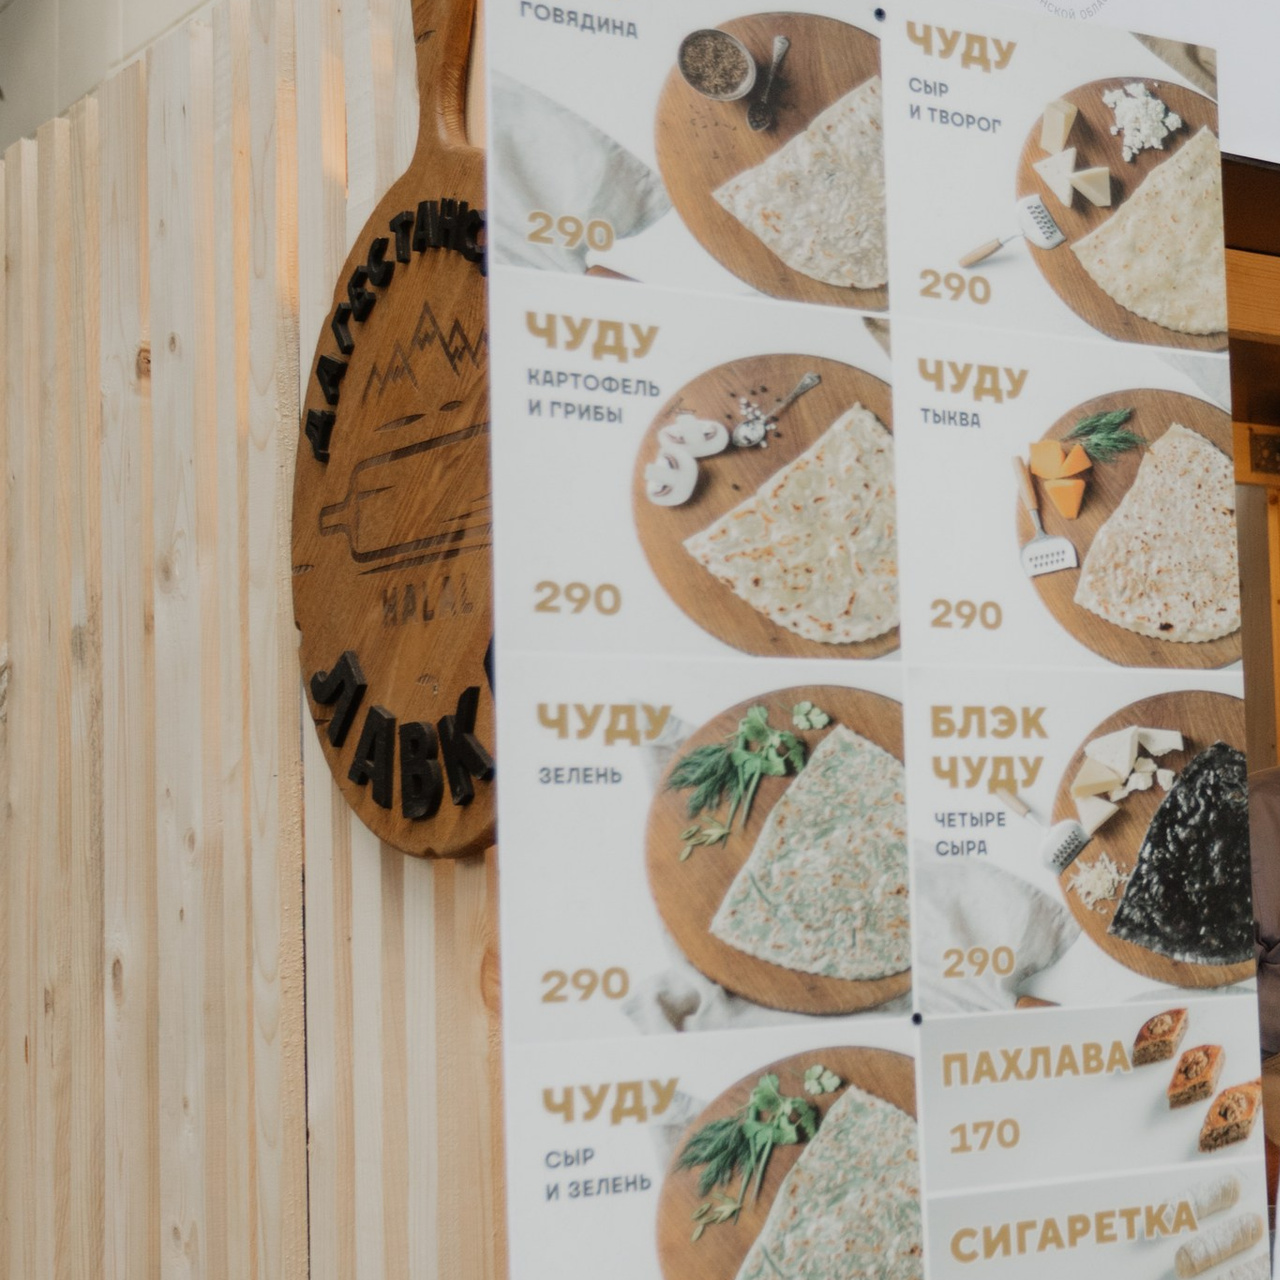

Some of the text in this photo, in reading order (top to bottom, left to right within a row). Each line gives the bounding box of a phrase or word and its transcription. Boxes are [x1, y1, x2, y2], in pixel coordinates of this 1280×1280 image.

[518, 0, 640, 40] ГОВЯДИНА
[906, 20, 1017, 72] ЧУДУ
[908, 77, 950, 98] СЫР
[909, 104, 1002, 135] И ТВОРОГ
[526, 209, 616, 253] 290
[919, 268, 992, 305] 290
[525, 310, 660, 364] ЧУДУ
[527, 367, 662, 398] КАРТОФЕЛЬ
[917, 357, 1030, 404] ЧУДУ
[527, 399, 624, 424] И ГРИБЫ
[920, 407, 982, 429] ТЫКВА
[534, 580, 623, 616] 290
[929, 598, 1003, 631] 290
[536, 702, 672, 747] ЧУДУ
[929, 705, 1049, 739] БЛЭК
[538, 766, 624, 785] ЗЕЛЕНЬ
[931, 755, 1045, 795] ЧУДУ
[934, 811, 1007, 828] ЧЕТЫРЕ
[934, 839, 988, 856] СЫРА
[941, 946, 1017, 979] 290
[540, 966, 631, 1005] 290
[941, 1040, 1133, 1088] ПАХЛАВА
[542, 1077, 680, 1125] ЧУДУ
[949, 1117, 1021, 1154] 170
[544, 1146, 596, 1171] СЫР
[545, 1174, 653, 1202] И ЗЕЛЕНЬ
[950, 1200, 1199, 1264] СИГАРЕТКА
